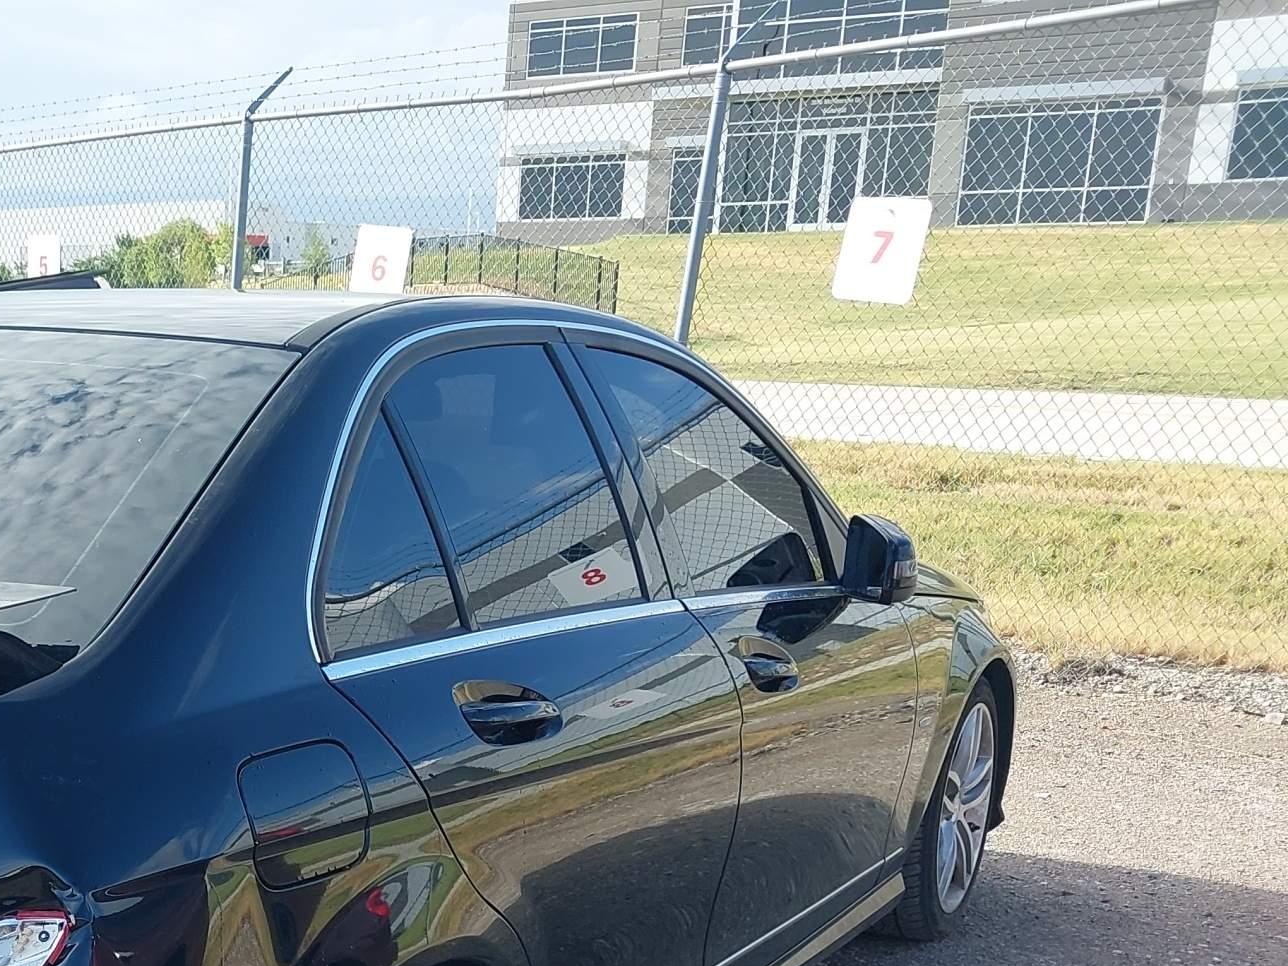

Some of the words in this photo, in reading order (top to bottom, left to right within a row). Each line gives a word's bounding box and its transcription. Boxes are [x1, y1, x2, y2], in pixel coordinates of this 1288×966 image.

[871, 230, 895, 264] 7
[39, 255, 48, 276] 5
[371, 255, 388, 281] 6
